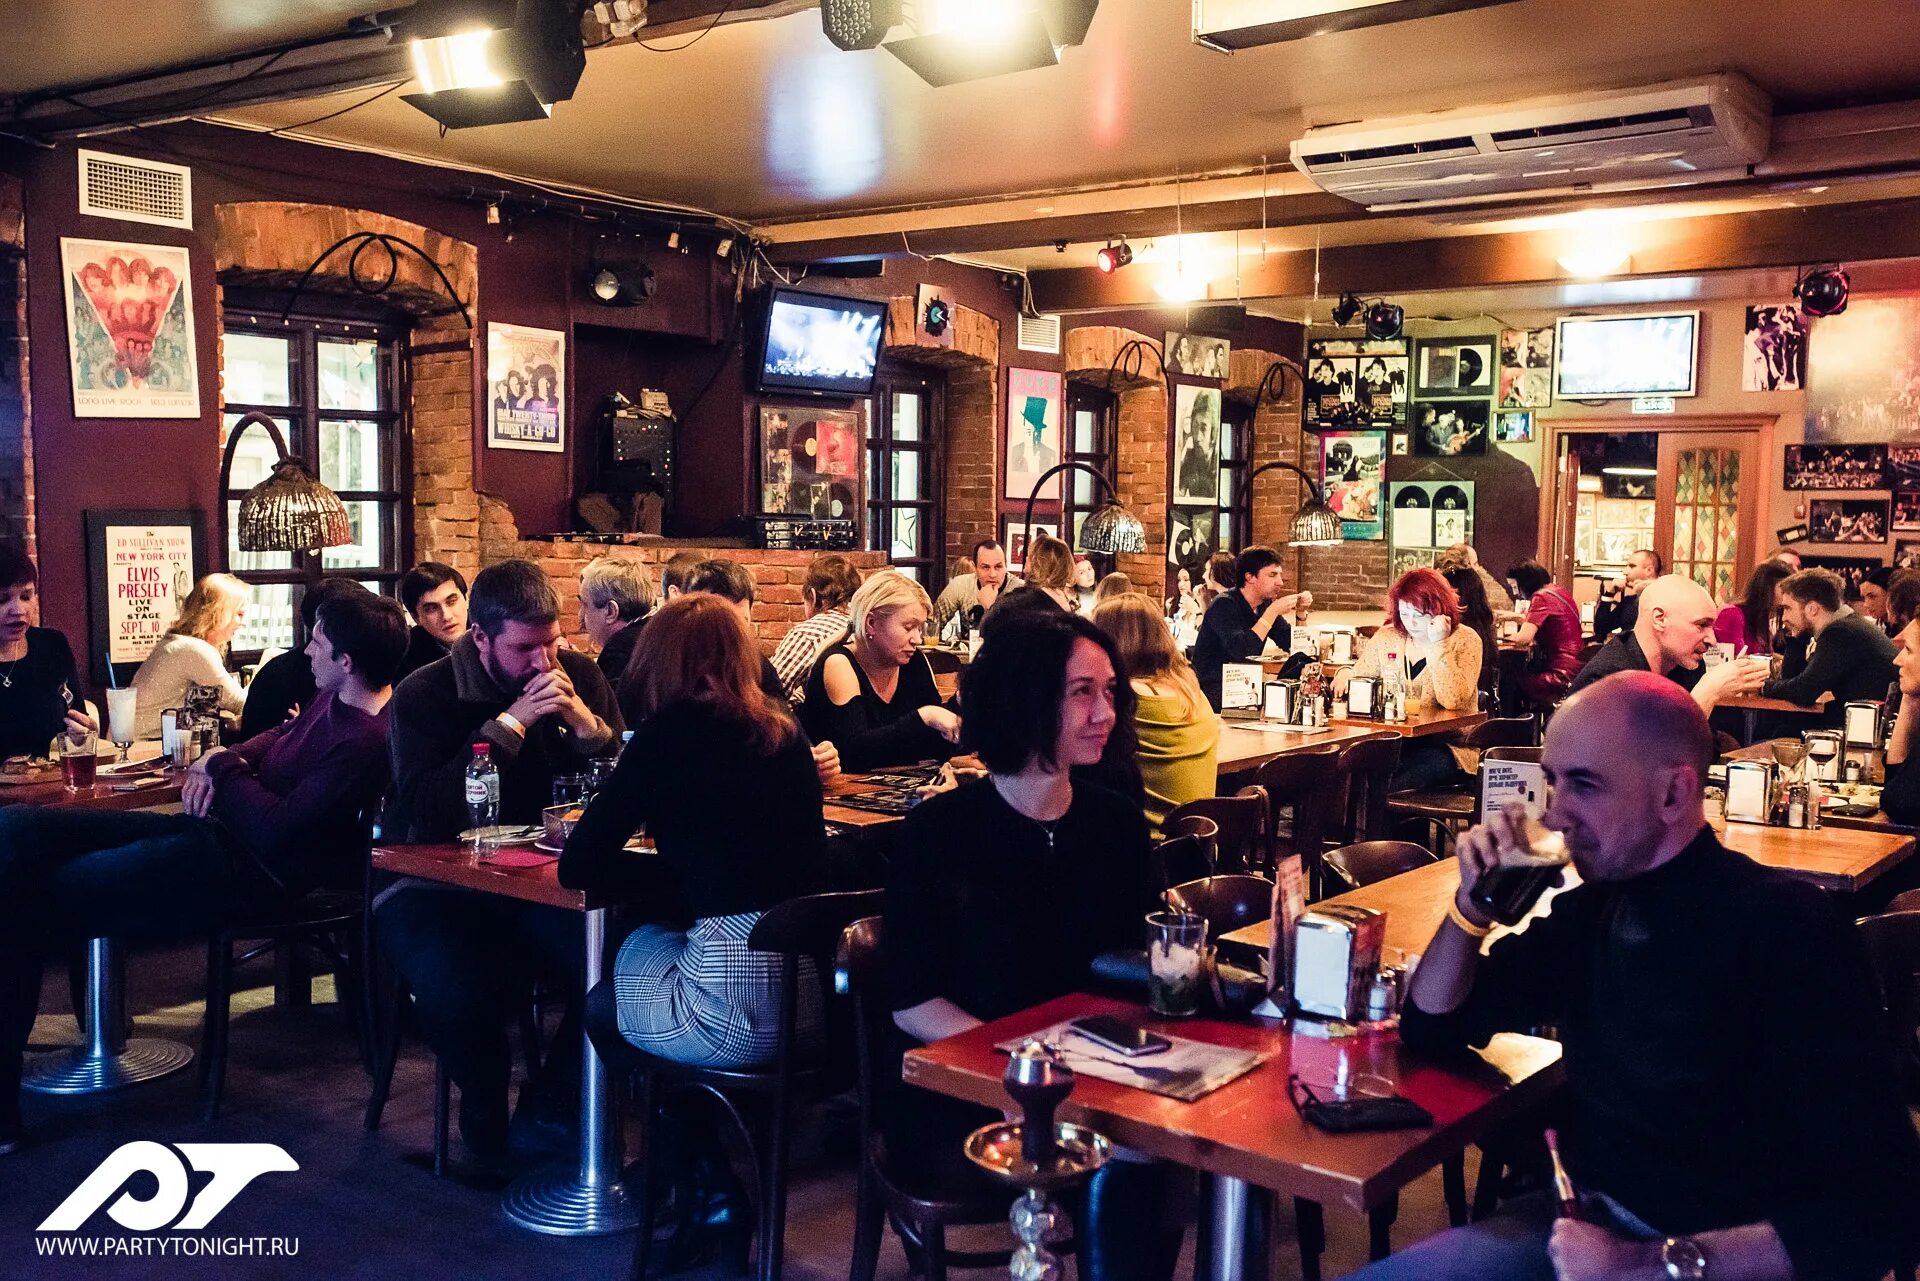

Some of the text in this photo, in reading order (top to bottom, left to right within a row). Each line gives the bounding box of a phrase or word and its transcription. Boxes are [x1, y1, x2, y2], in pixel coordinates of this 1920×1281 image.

[129, 538, 164, 547] SULLIVAN
[166, 538, 185, 547] SHOW
[116, 552, 188, 561] NEW YORK CITY
[127, 566, 160, 582] ELVIS
[118, 582, 168, 598] PRESLEY
[128, 598, 153, 607] LIVE
[127, 612, 161, 620] STAGE
[120, 620, 160, 634] SEPT. 10
